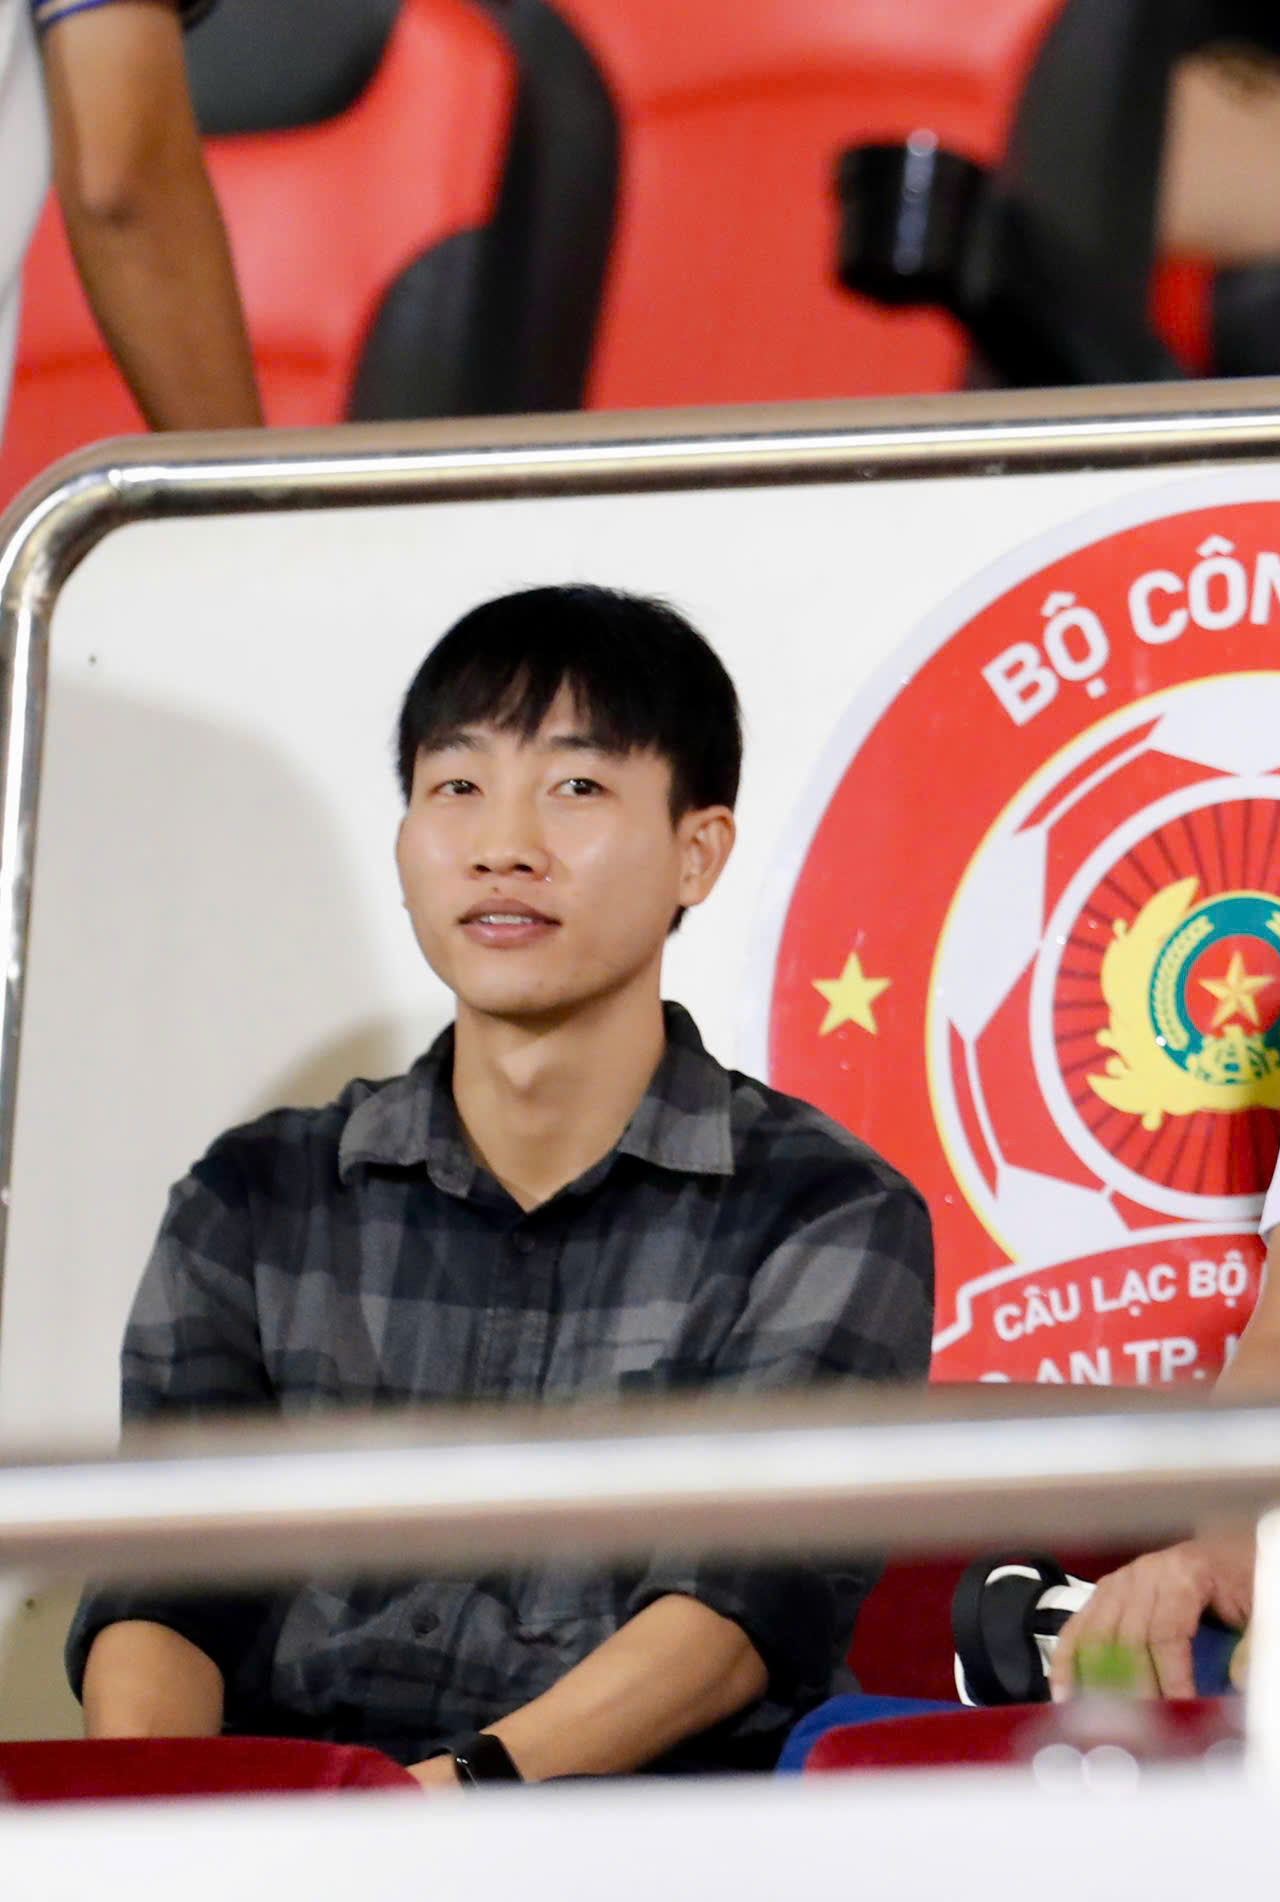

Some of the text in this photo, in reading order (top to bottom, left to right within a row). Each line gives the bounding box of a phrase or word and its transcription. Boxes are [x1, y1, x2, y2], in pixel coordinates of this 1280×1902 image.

[982, 591, 1110, 726] BỘ
[993, 1249, 1248, 1342] CÂU LẠC BỘ
[1122, 1336, 1206, 1386] TP.
